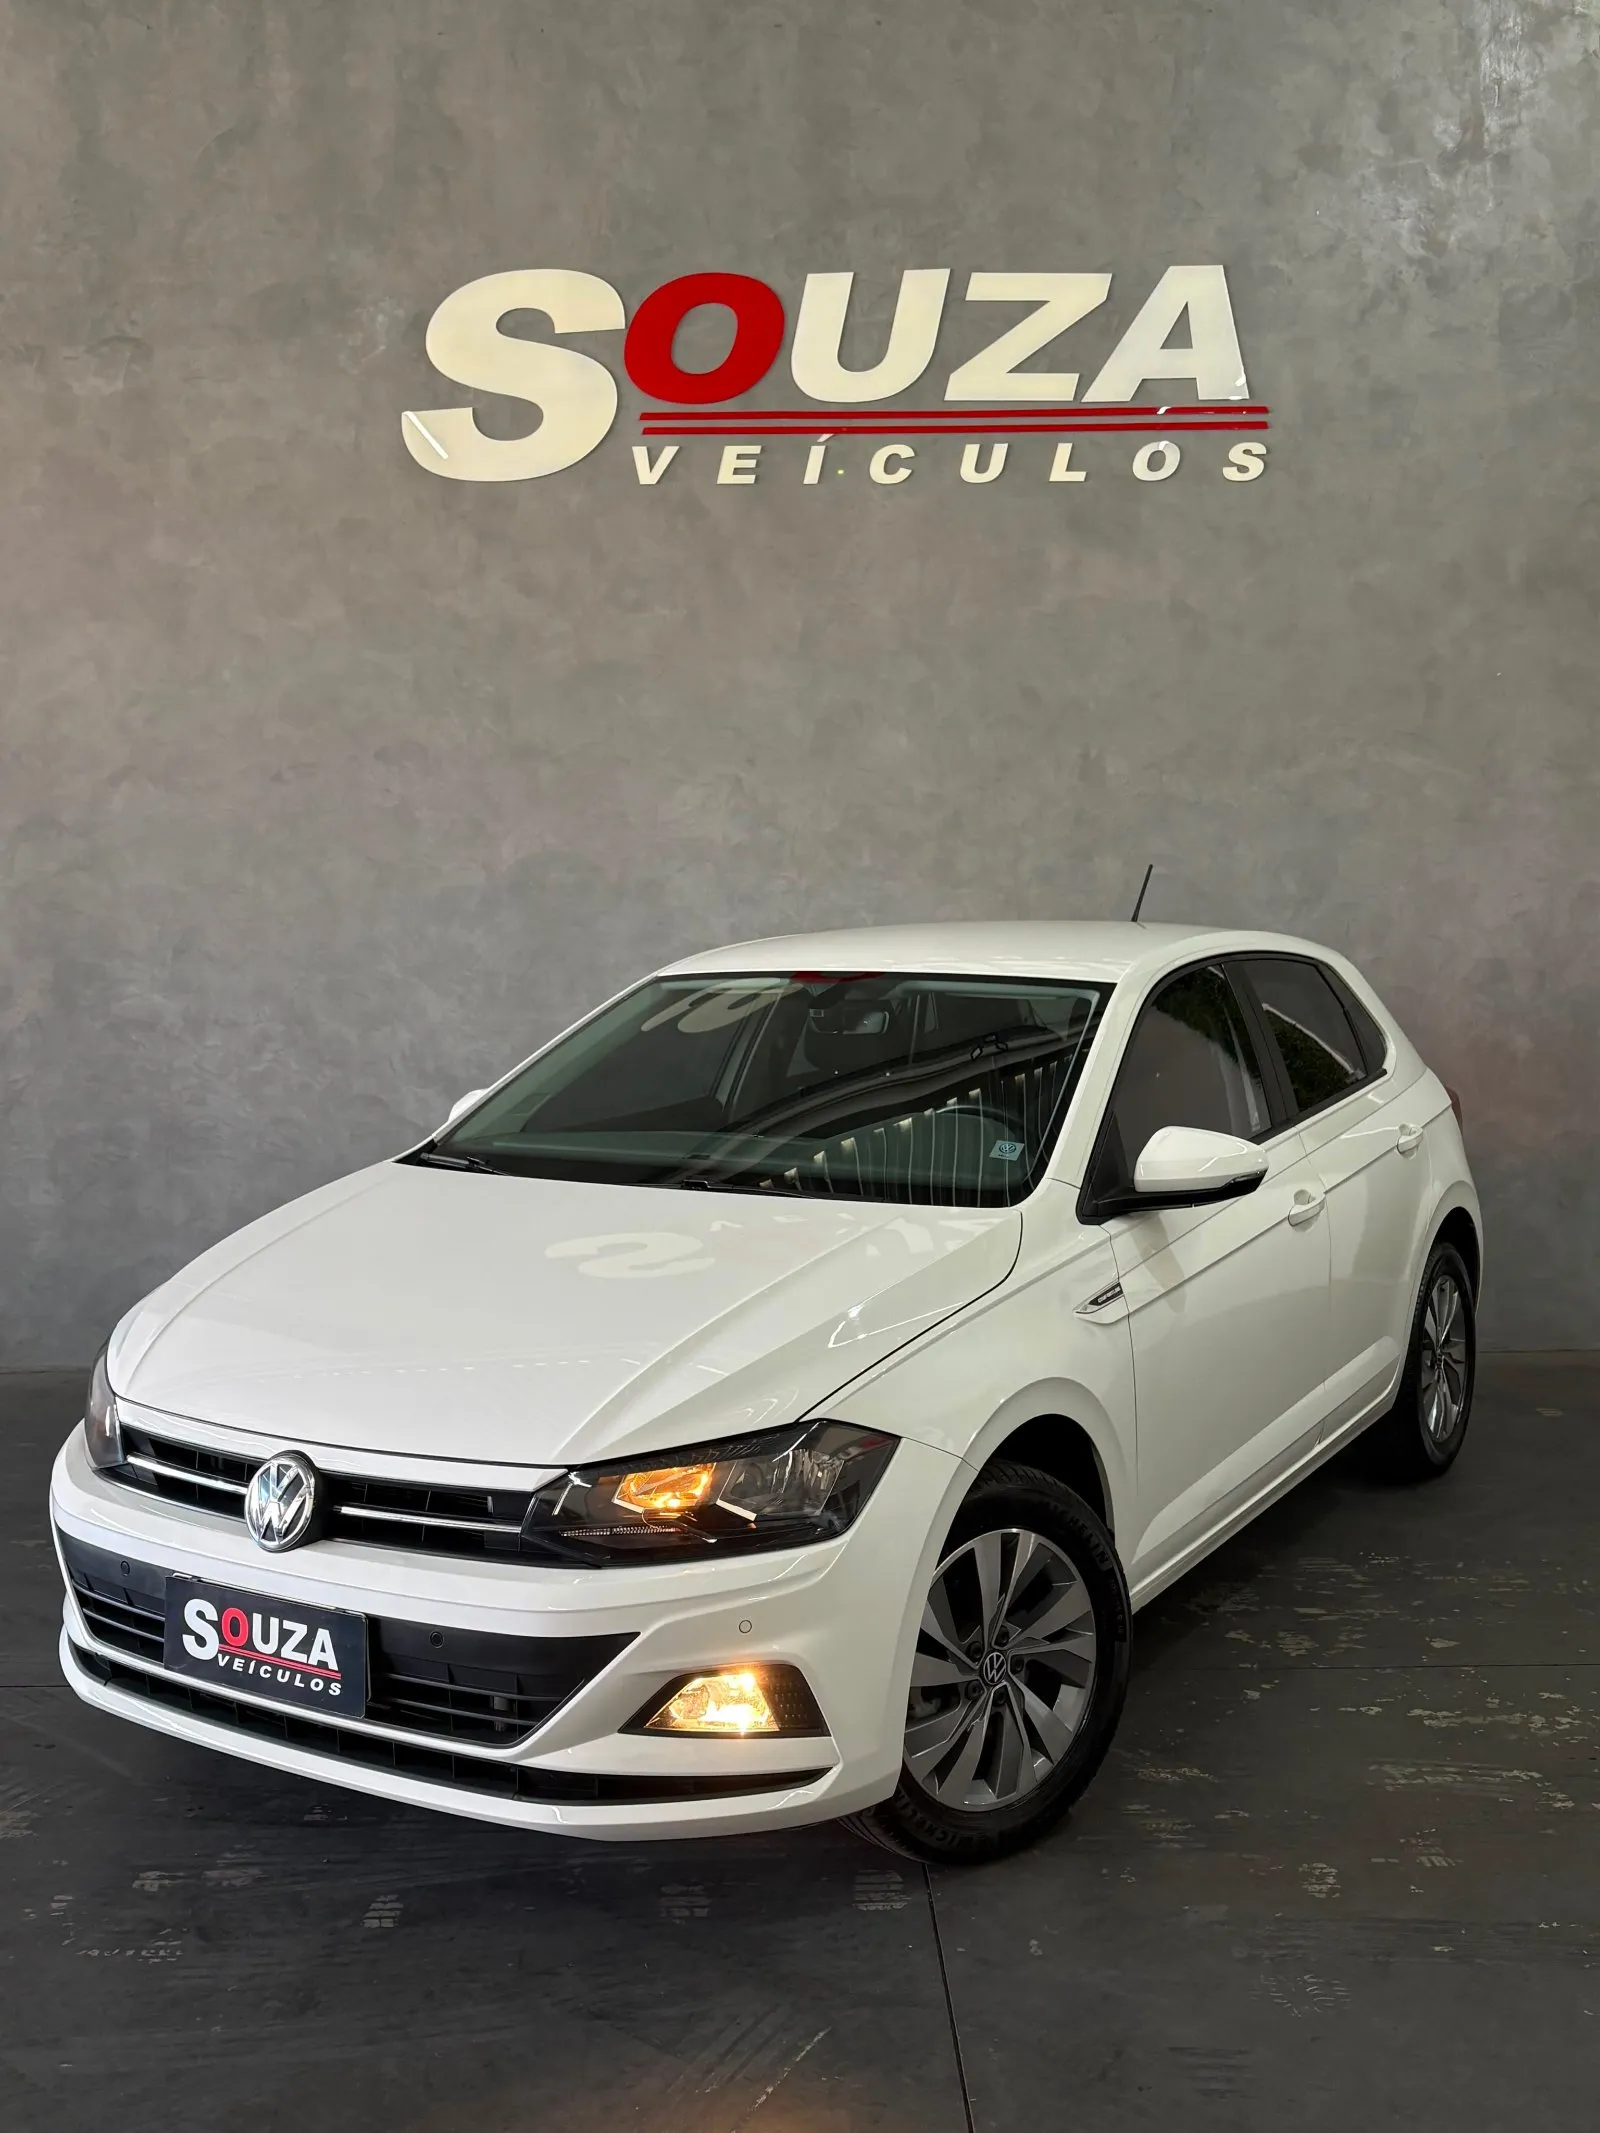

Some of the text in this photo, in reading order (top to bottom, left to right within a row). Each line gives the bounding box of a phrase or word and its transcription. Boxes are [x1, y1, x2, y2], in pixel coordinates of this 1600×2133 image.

[402, 265, 1250, 481] SOUZA
[632, 433, 1267, 485] VEÍCULOS
[182, 1599, 339, 1671] SOUZA
[218, 1653, 342, 1696] VEÍCULOS
